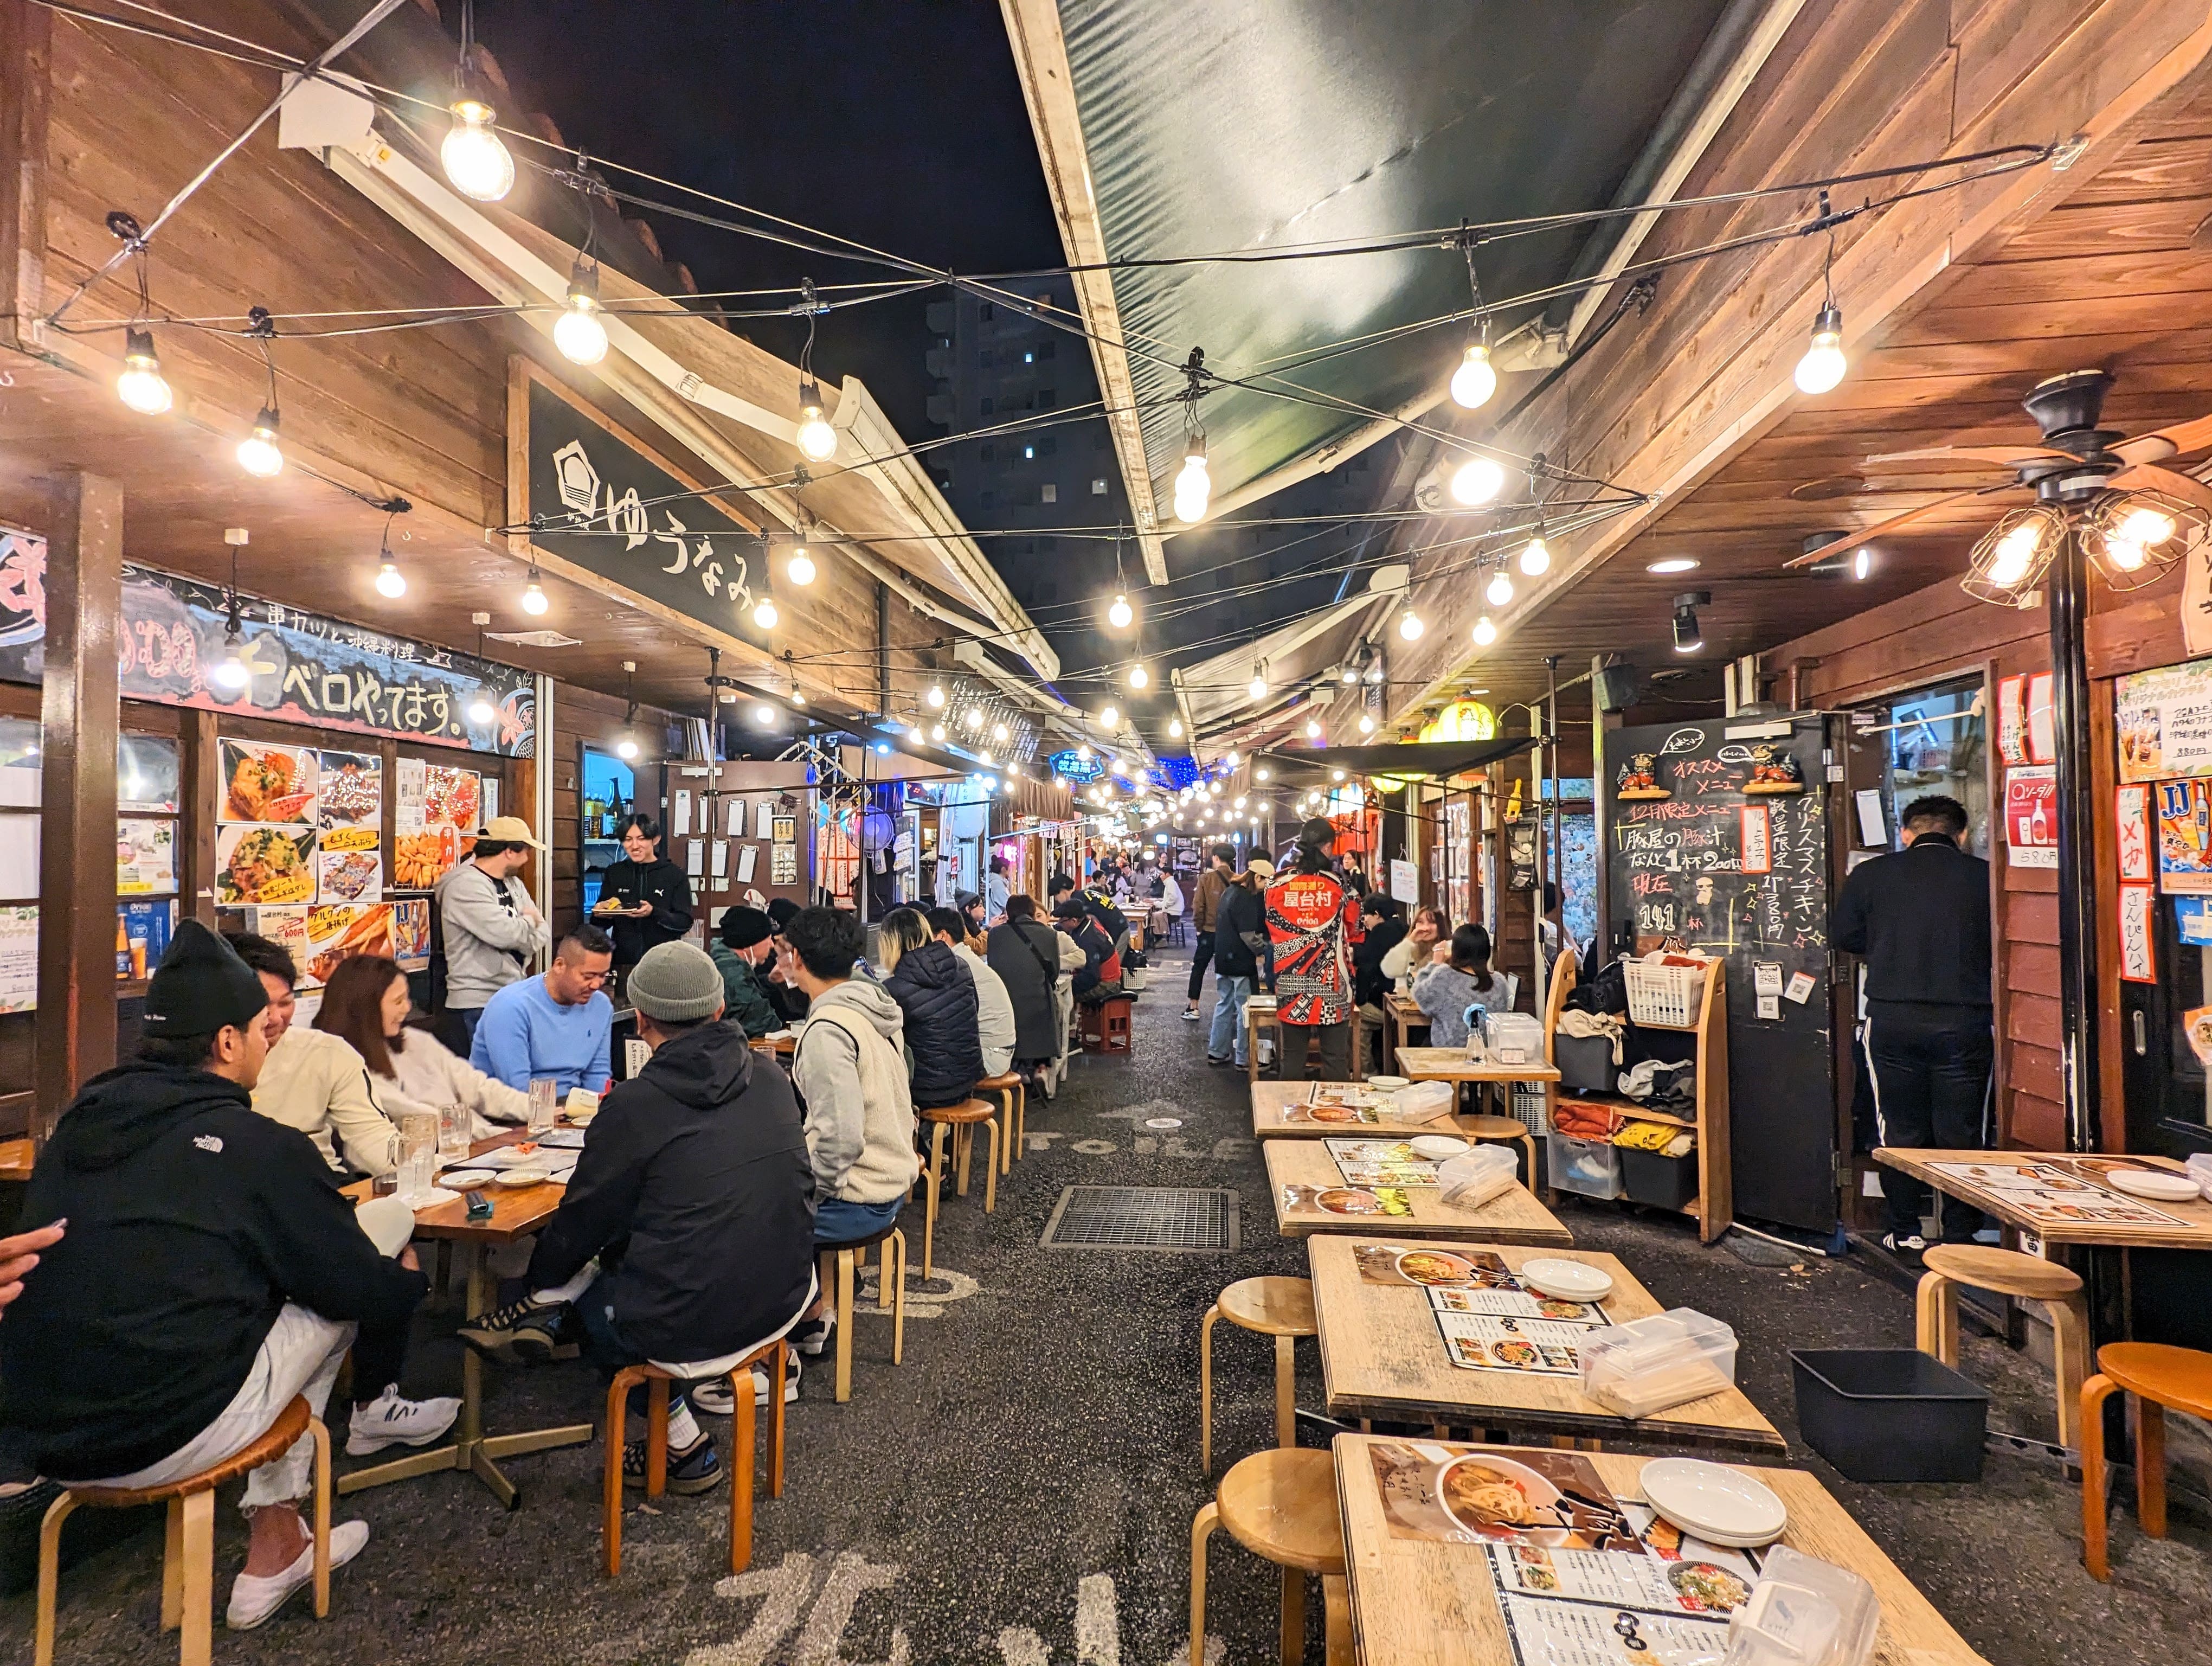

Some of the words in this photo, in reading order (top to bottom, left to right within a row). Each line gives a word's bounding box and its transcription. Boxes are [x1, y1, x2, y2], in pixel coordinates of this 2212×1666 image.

[606, 483, 755, 611] ゆうなみ
[268, 604, 422, 662] 串カツと沖縄料理
[1673, 759, 1726, 778] オススメ
[1696, 774, 1744, 795] メニュー
[2162, 782, 2190, 819] JJ
[1629, 802, 1746, 823] 12月限定メニュー
[330, 832, 351, 843] もずく
[1768, 798, 1792, 870] 数量限定
[1791, 797, 1817, 933] クリスマスチキン
[2021, 851, 2057, 864] 580円
[1632, 873, 1673, 896] 現在
[1283, 890, 1332, 907] 屋台村
[309, 906, 351, 923] グルクンの
[326, 917, 350, 931] 唐揚げ
[1639, 904, 1676, 933] 141
[1687, 915, 1703, 928] 杯
[285, 928, 304, 938] 600円
[2126, 891, 2144, 978] さんぴんハイ
